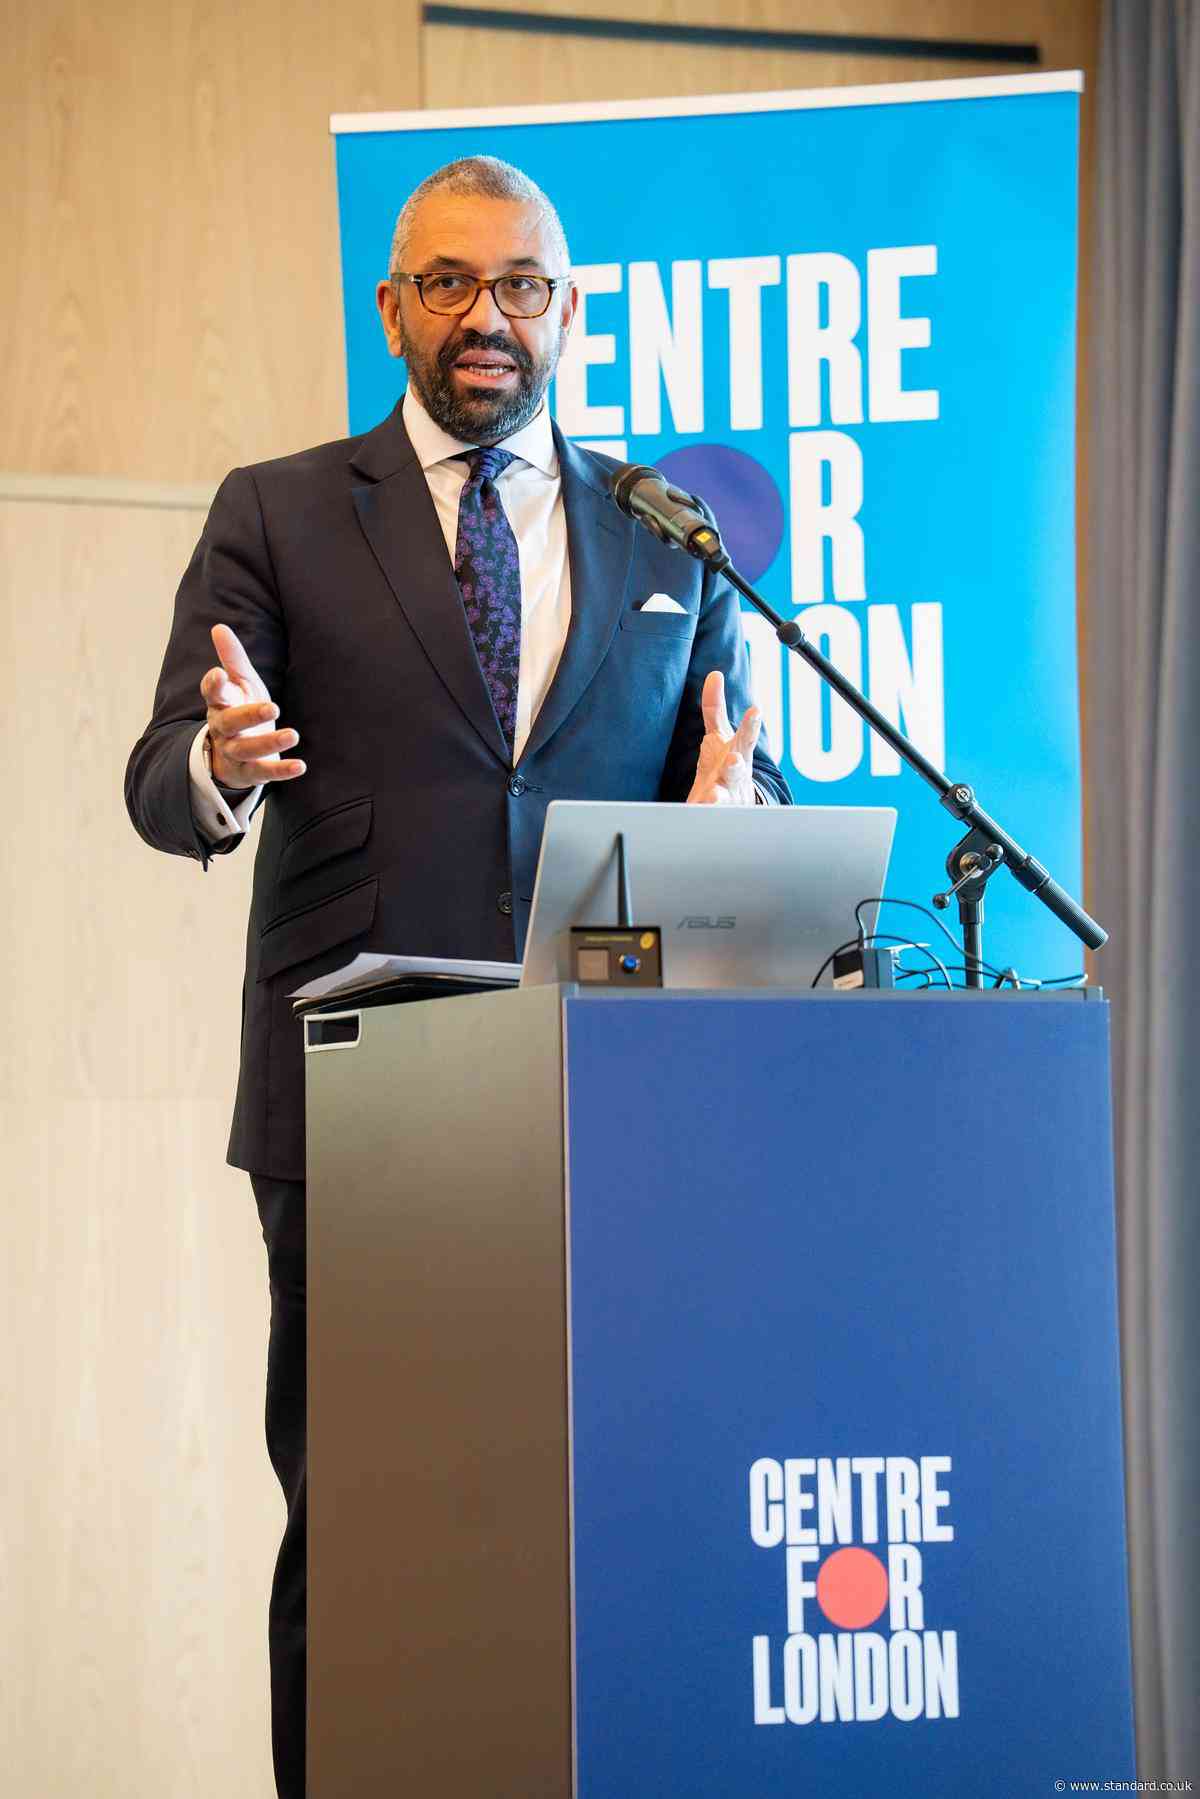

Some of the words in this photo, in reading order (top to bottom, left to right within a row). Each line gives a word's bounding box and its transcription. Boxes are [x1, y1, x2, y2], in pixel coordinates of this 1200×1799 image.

[556, 244, 940, 438] ENTRE
[750, 1456, 954, 1548] CENTRE
[786, 1543, 925, 1634] FOR
[753, 1630, 960, 1725] LONDON
